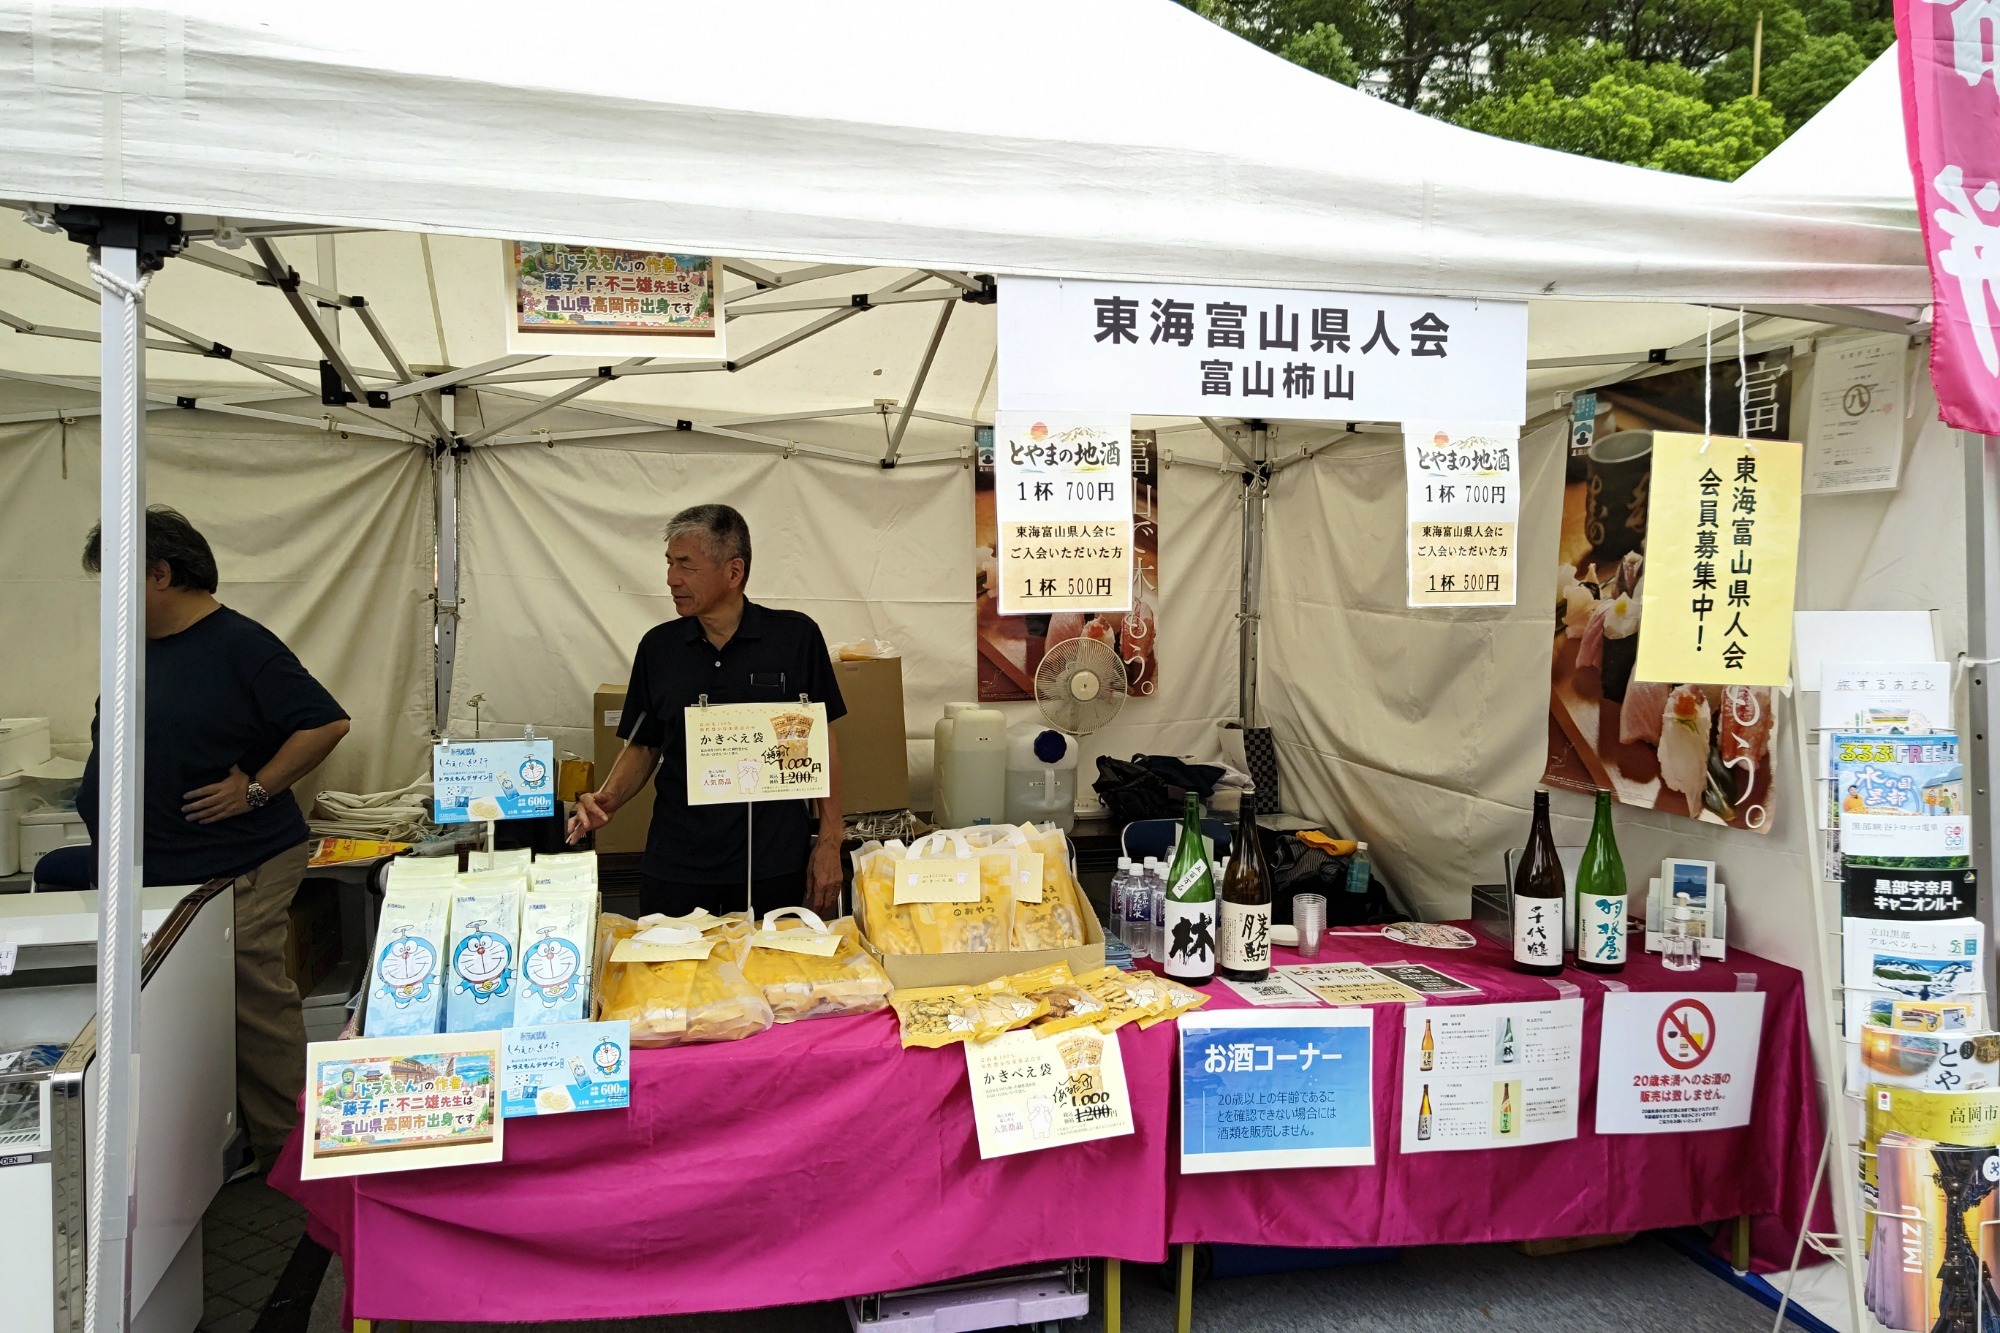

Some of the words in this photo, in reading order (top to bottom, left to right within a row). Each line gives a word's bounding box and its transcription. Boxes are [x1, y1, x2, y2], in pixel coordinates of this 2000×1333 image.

[556, 253, 676, 274] 「ドラえもん」の作者
[545, 272, 690, 294] 藤子・F・不二雄先生は
[545, 295, 693, 316] 富山県高岡市出身です
[1094, 296, 1450, 358] 東海富山県人会
[1200, 359, 1355, 401] 富山柿山
[1009, 440, 1120, 467] とやまの地酒
[1417, 447, 1510, 472] とやまの地酒
[1018, 481, 1054, 501] 1杯
[1066, 482, 1114, 501] 700円
[1426, 484, 1455, 503] 1杯
[1466, 485, 1505, 504] 700円
[1016, 525, 1116, 538] 東海富山県人会に
[1422, 525, 1503, 538] 東海富山県人会に
[1011, 546, 1122, 559] ご入会いただいた方
[1417, 545, 1508, 557] ご入会いただいた方
[1691, 467, 1722, 652] 会員募集中！
[1722, 454, 1758, 670] 東海富山県人会
[1025, 578, 1056, 596] 1杯
[1068, 578, 1111, 596] 500円
[1430, 574, 1455, 591] 1杯
[1464, 574, 1500, 591] 500円
[1837, 678, 1935, 690] 旅するあさひ
[700, 732, 764, 745] かきべえ袋
[703, 778, 732, 787] 人気商品
[1852, 822, 1938, 832] 黒部峡谷トロッコ電車
[1874, 879, 1953, 896] 黒部宇奈月
[1874, 896, 1964, 911] キャニオンルート
[1242, 913, 1269, 962] 勝駒
[1527, 906, 1548, 959] 千代鶴
[1595, 899, 1624, 960] 羽根屋
[1870, 928, 1911, 939] 立山黒部
[1868, 937, 1937, 951] アルペンルート
[1204, 1042, 1343, 1072] お酒コーナー
[983, 1063, 1052, 1085] かきべえ袋
[1633, 1073, 1731, 1087] 20歳未満へのお酒の
[354, 1075, 463, 1097] 「ドラえもん」の作者
[342, 1094, 474, 1117] 藤子・F・不二雄先生は
[1218, 1091, 1336, 1105] 20歳以上の年齢であるこ
[1640, 1089, 1726, 1103] 販売は致しません。
[340, 1112, 475, 1136] 富山県高岡市出身です
[1217, 1107, 1336, 1123] とを確認できない場合には
[1949, 1105, 1999, 1124] 高岡市
[1217, 1125, 1314, 1140] 酒類を販売しません。
[1901, 1205, 1923, 1274] IMIZU
